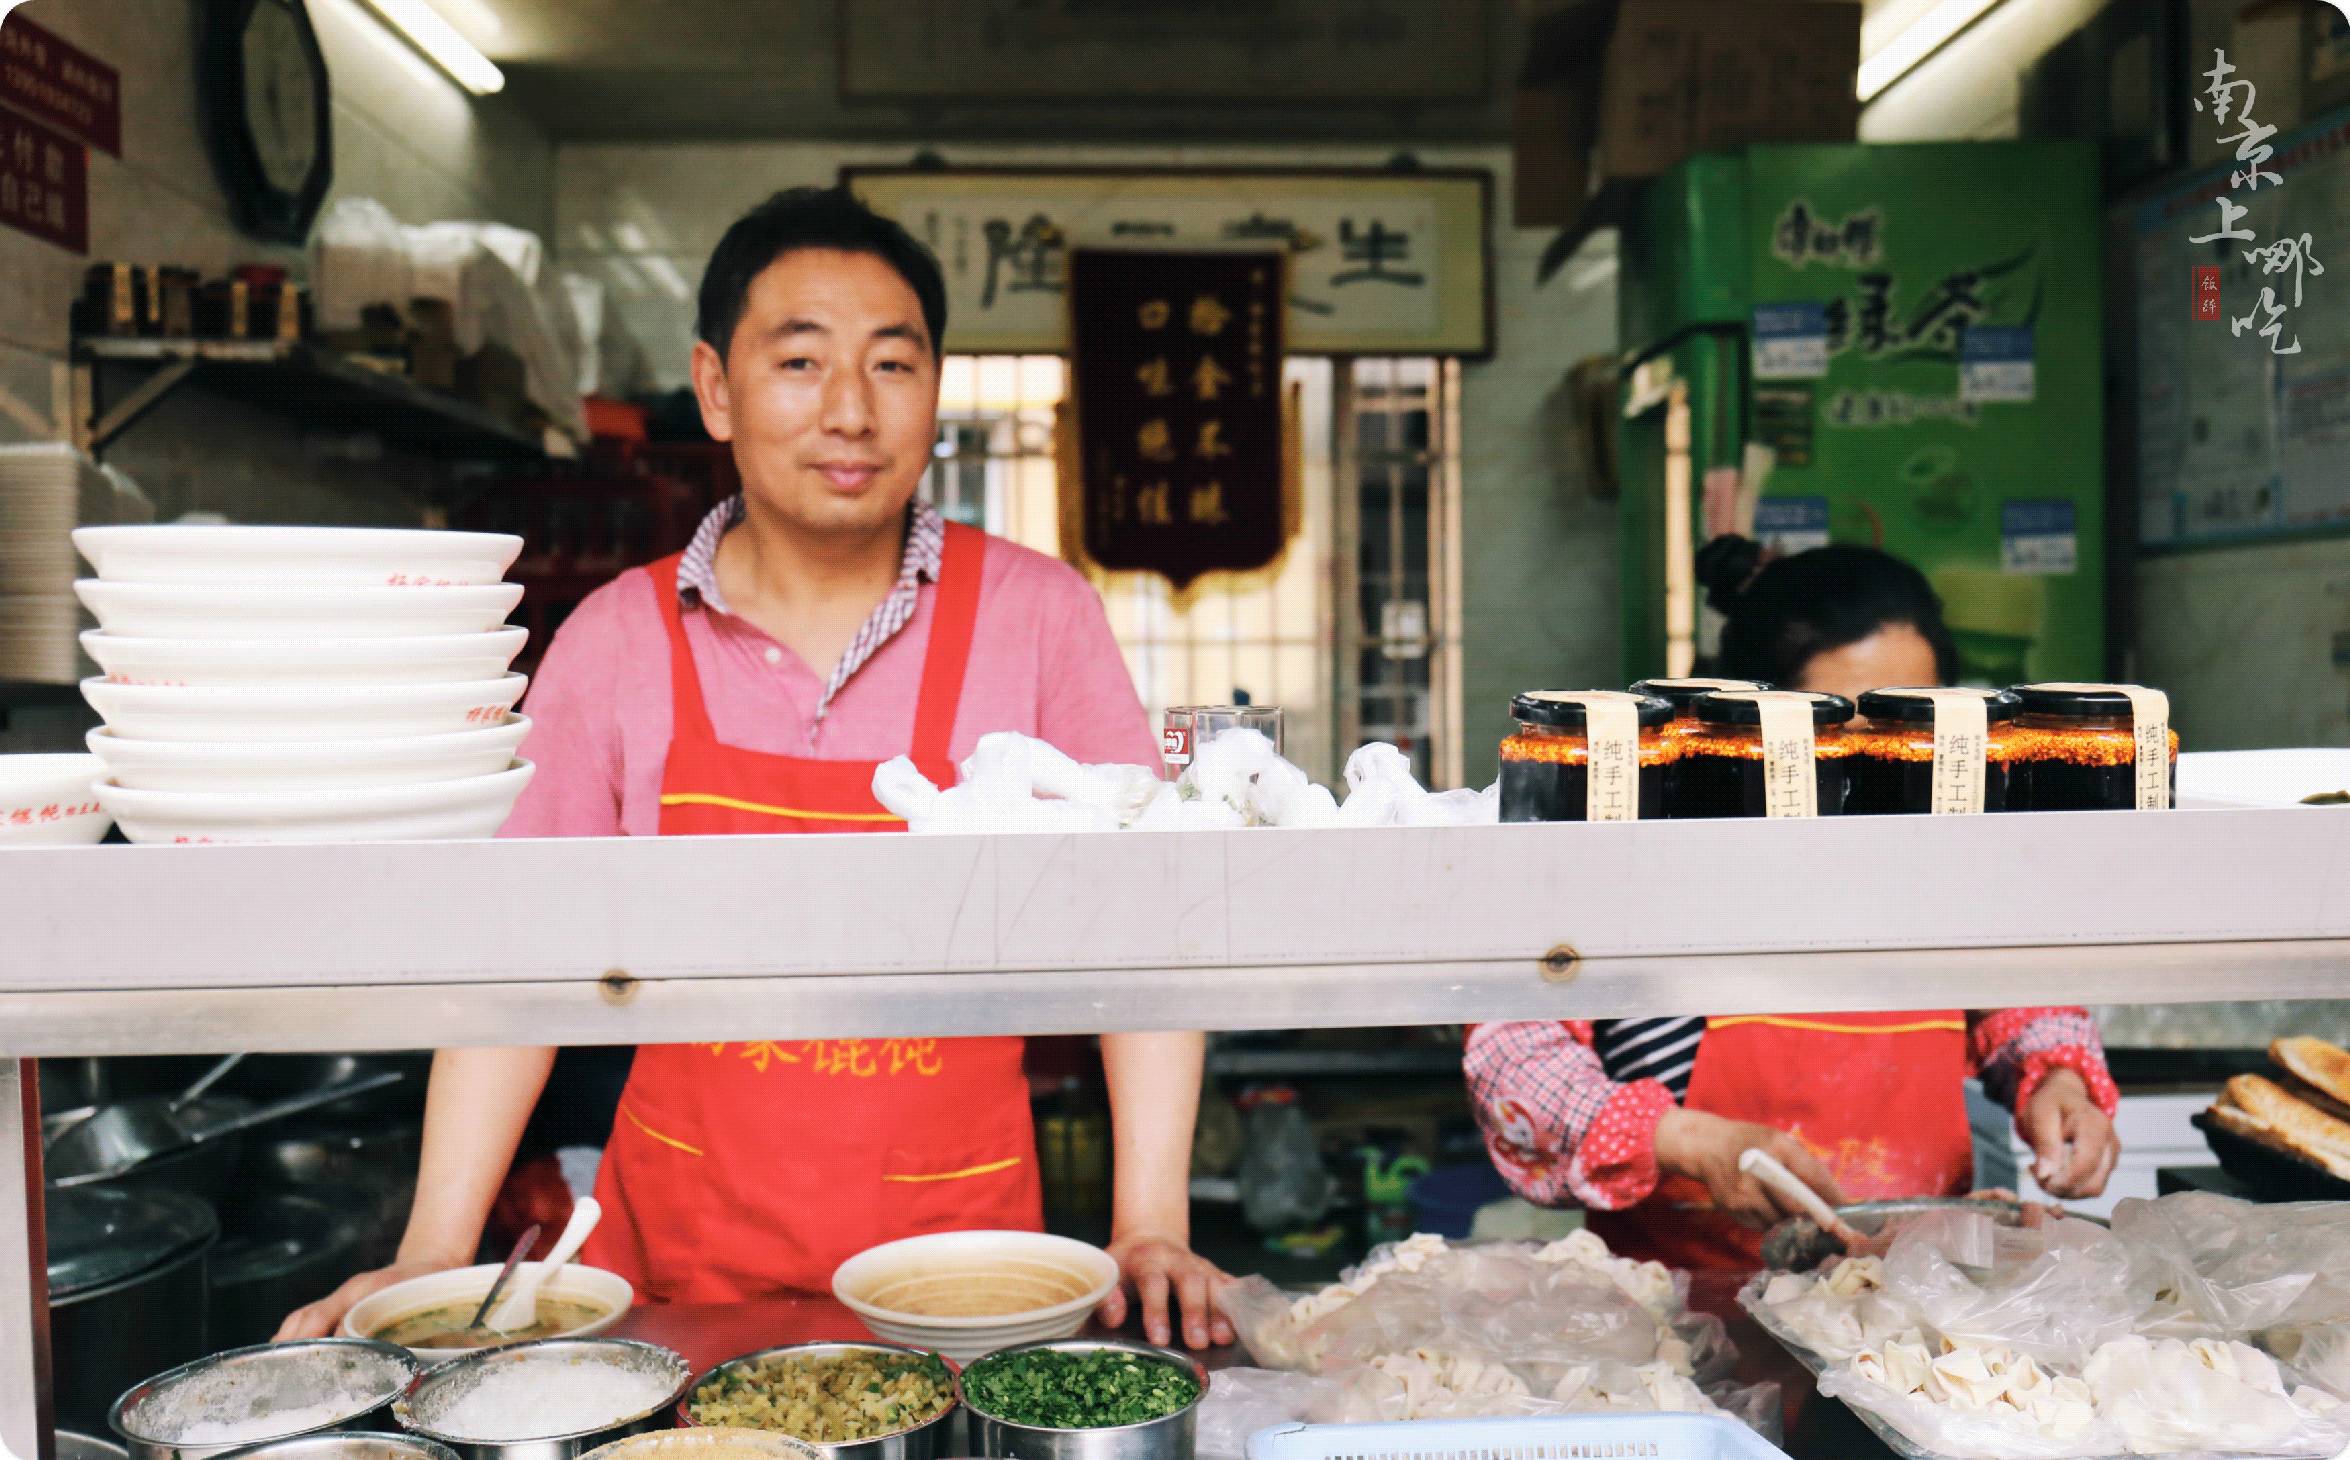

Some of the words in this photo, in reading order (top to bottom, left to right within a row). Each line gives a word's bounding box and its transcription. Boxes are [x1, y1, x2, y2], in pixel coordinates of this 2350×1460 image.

[1779, 739, 1801, 817] 纯手工
[691, 1037, 944, 1078] 家馄饨
